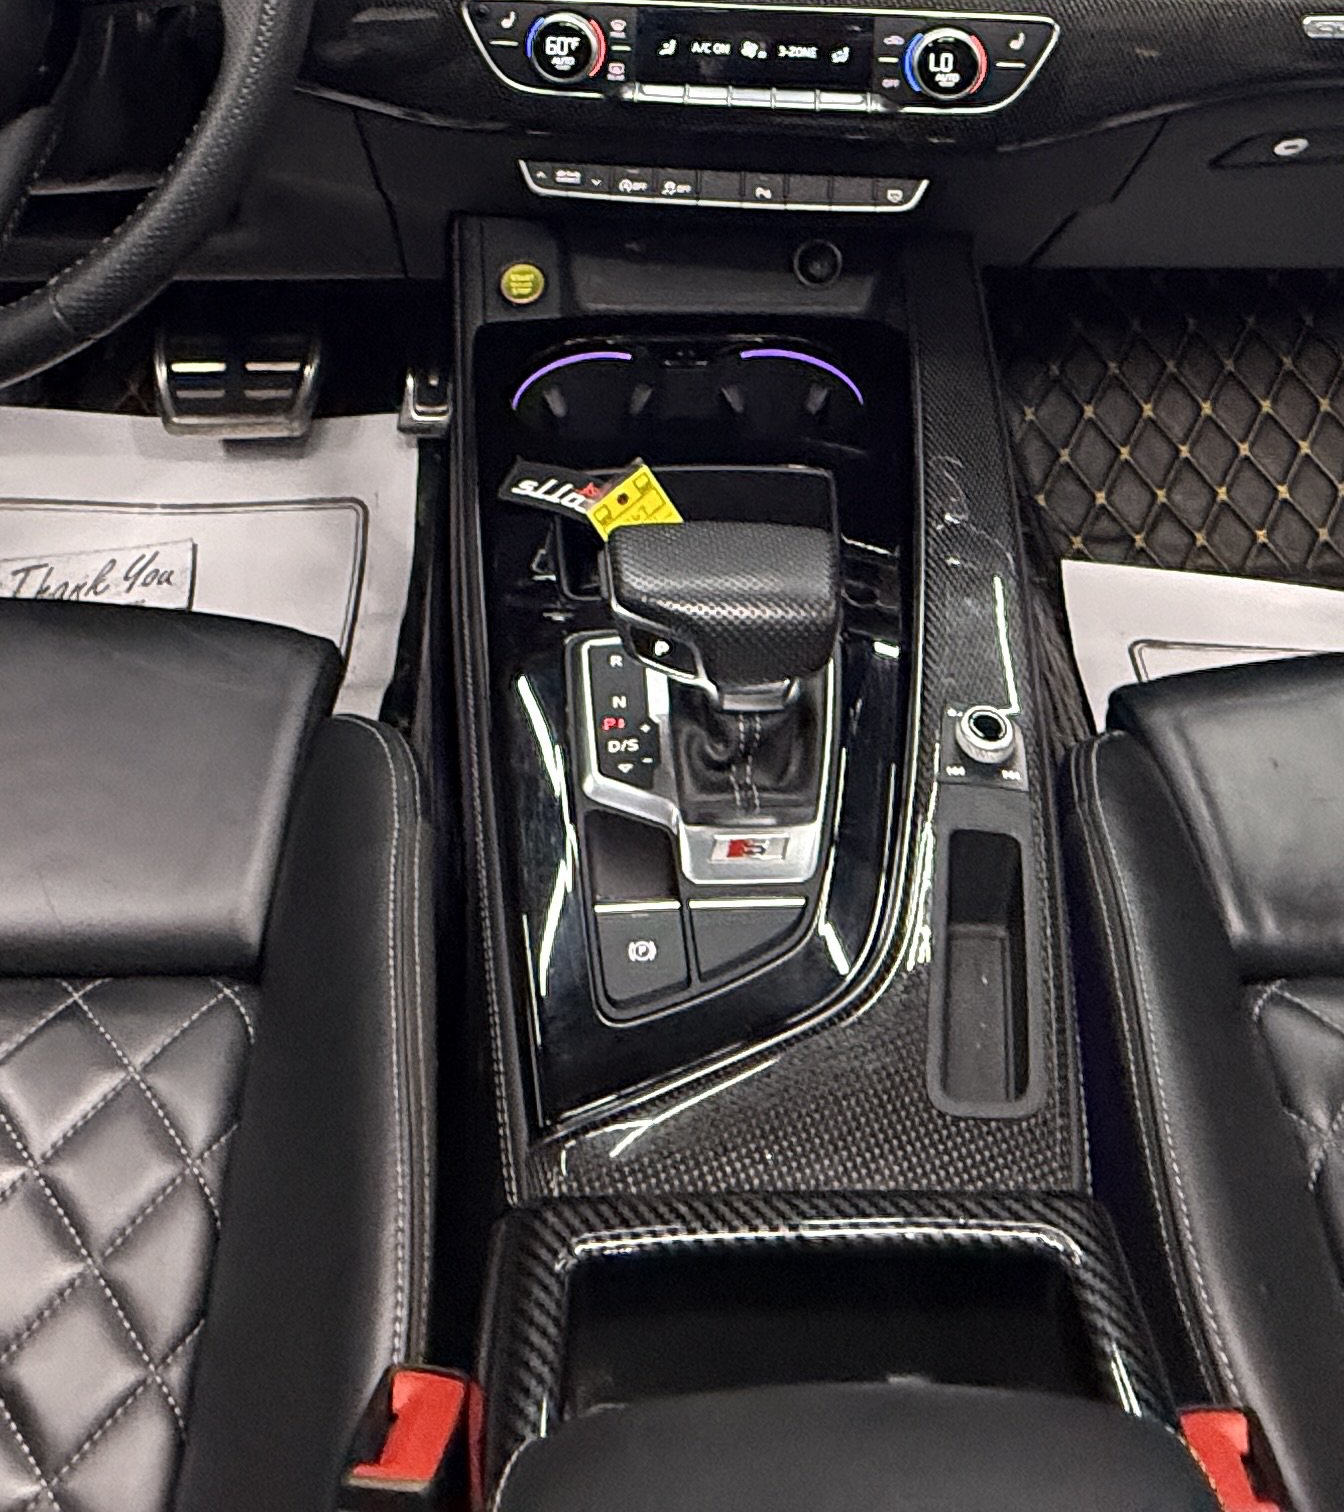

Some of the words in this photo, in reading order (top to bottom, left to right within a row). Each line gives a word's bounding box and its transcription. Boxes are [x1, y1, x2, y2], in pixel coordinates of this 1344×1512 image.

[123, 551, 174, 594] You
[655, 640, 670, 656] P
[610, 655, 623, 668] R
[612, 696, 627, 709] N
[608, 739, 639, 753] D/S
